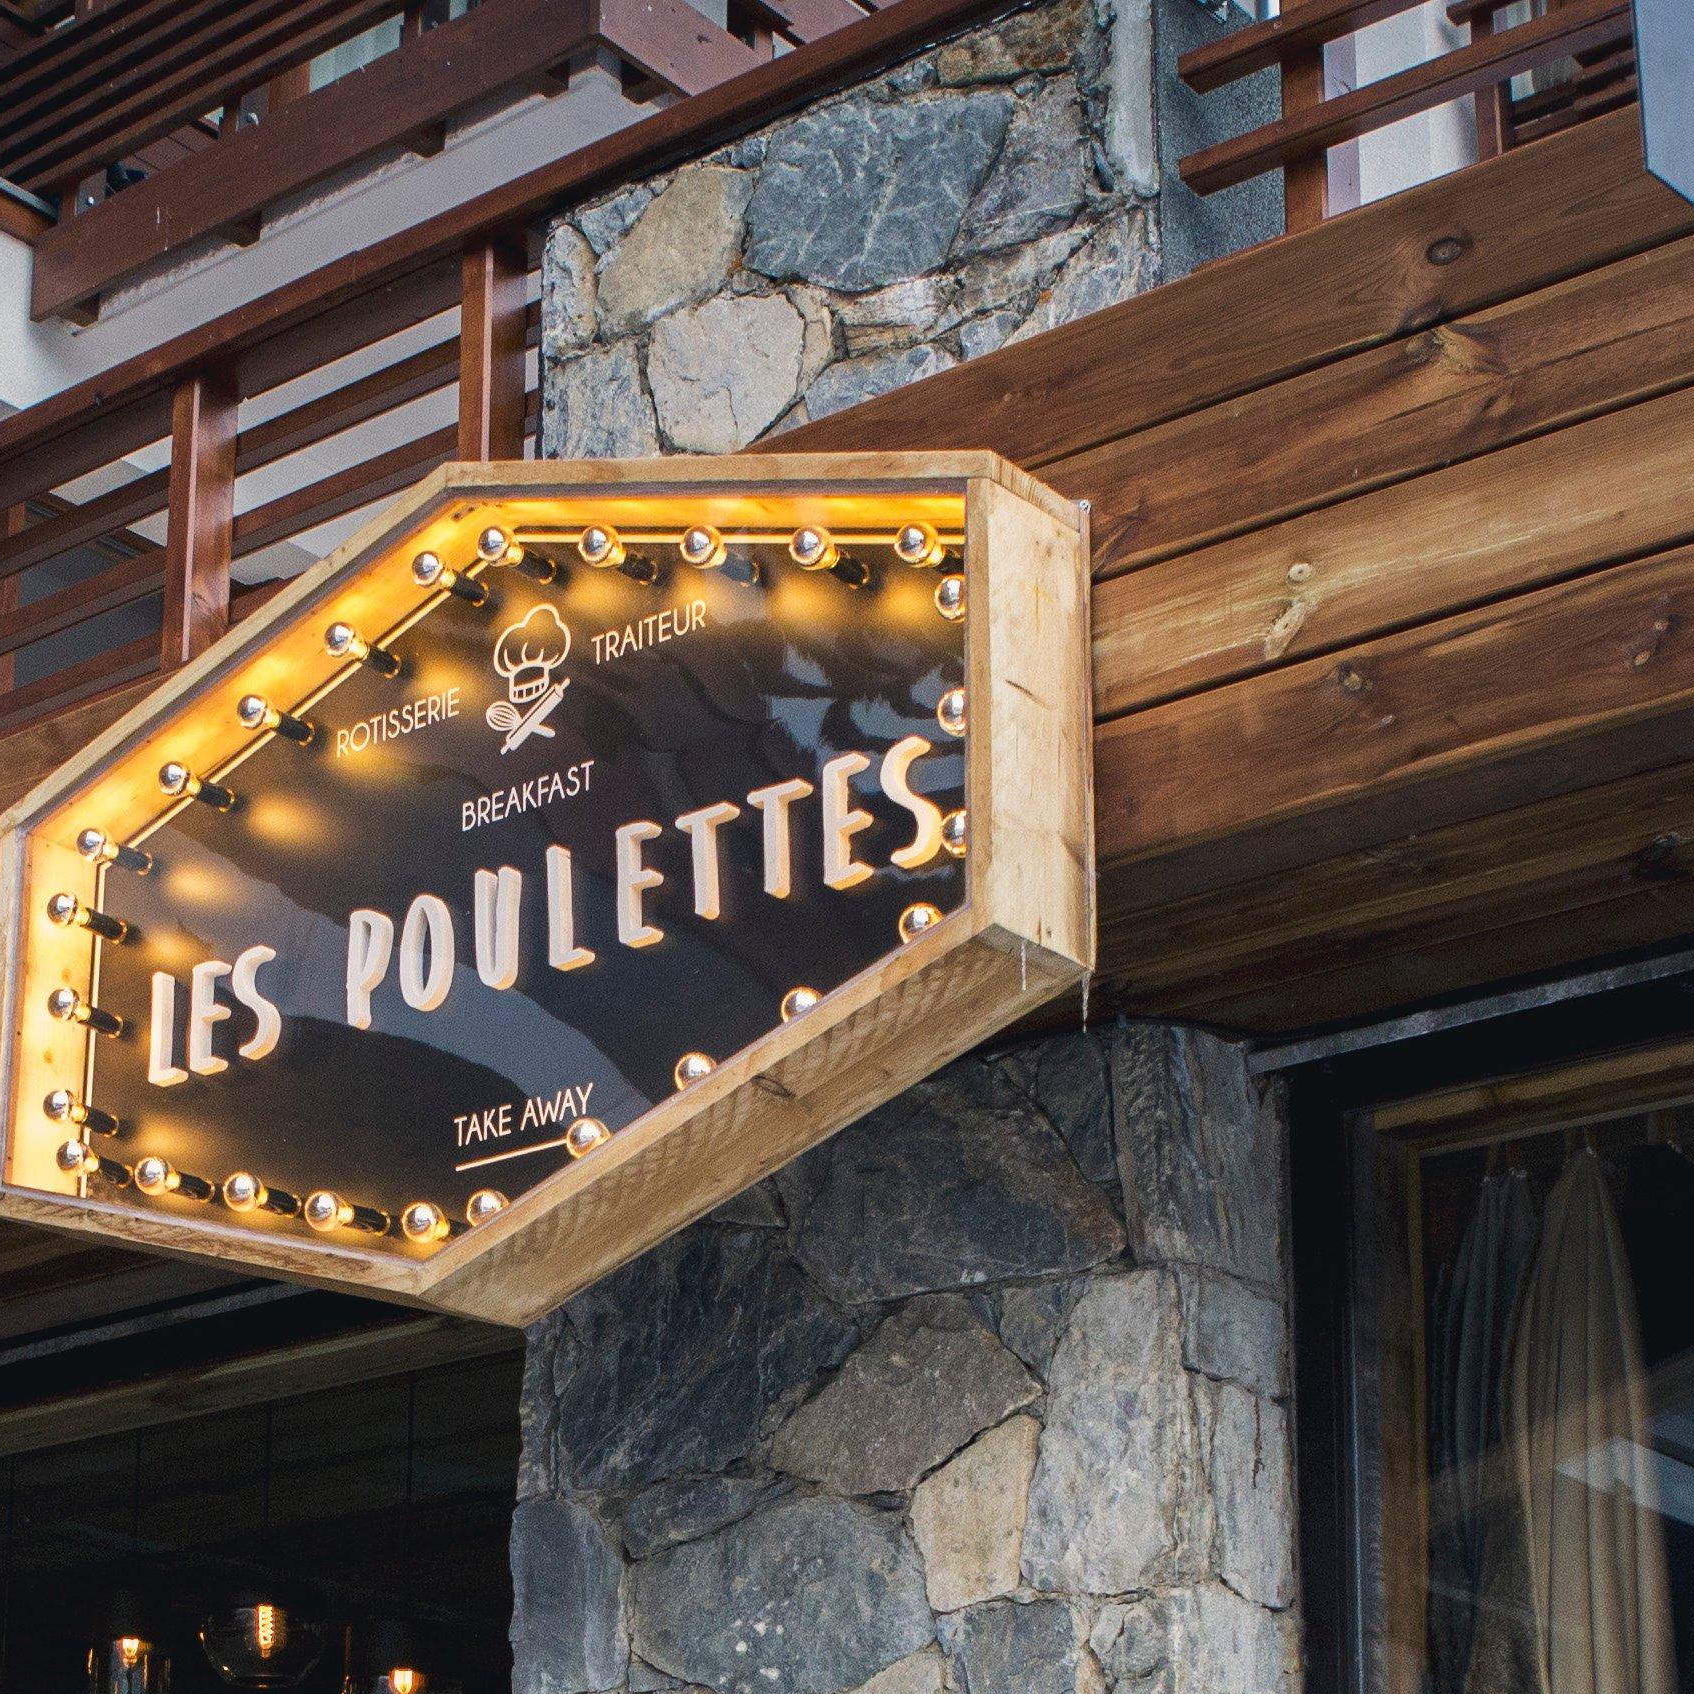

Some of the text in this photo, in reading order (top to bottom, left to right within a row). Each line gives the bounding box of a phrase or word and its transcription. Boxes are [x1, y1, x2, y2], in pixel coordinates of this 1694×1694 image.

[591, 599, 708, 664] TRAITEUR
[335, 686, 461, 758] ROTISSERIE
[461, 758, 594, 833] BREAKFAST
[147, 735, 945, 1086] LES POULETTES
[454, 1082, 594, 1150] TAKE AWAY
